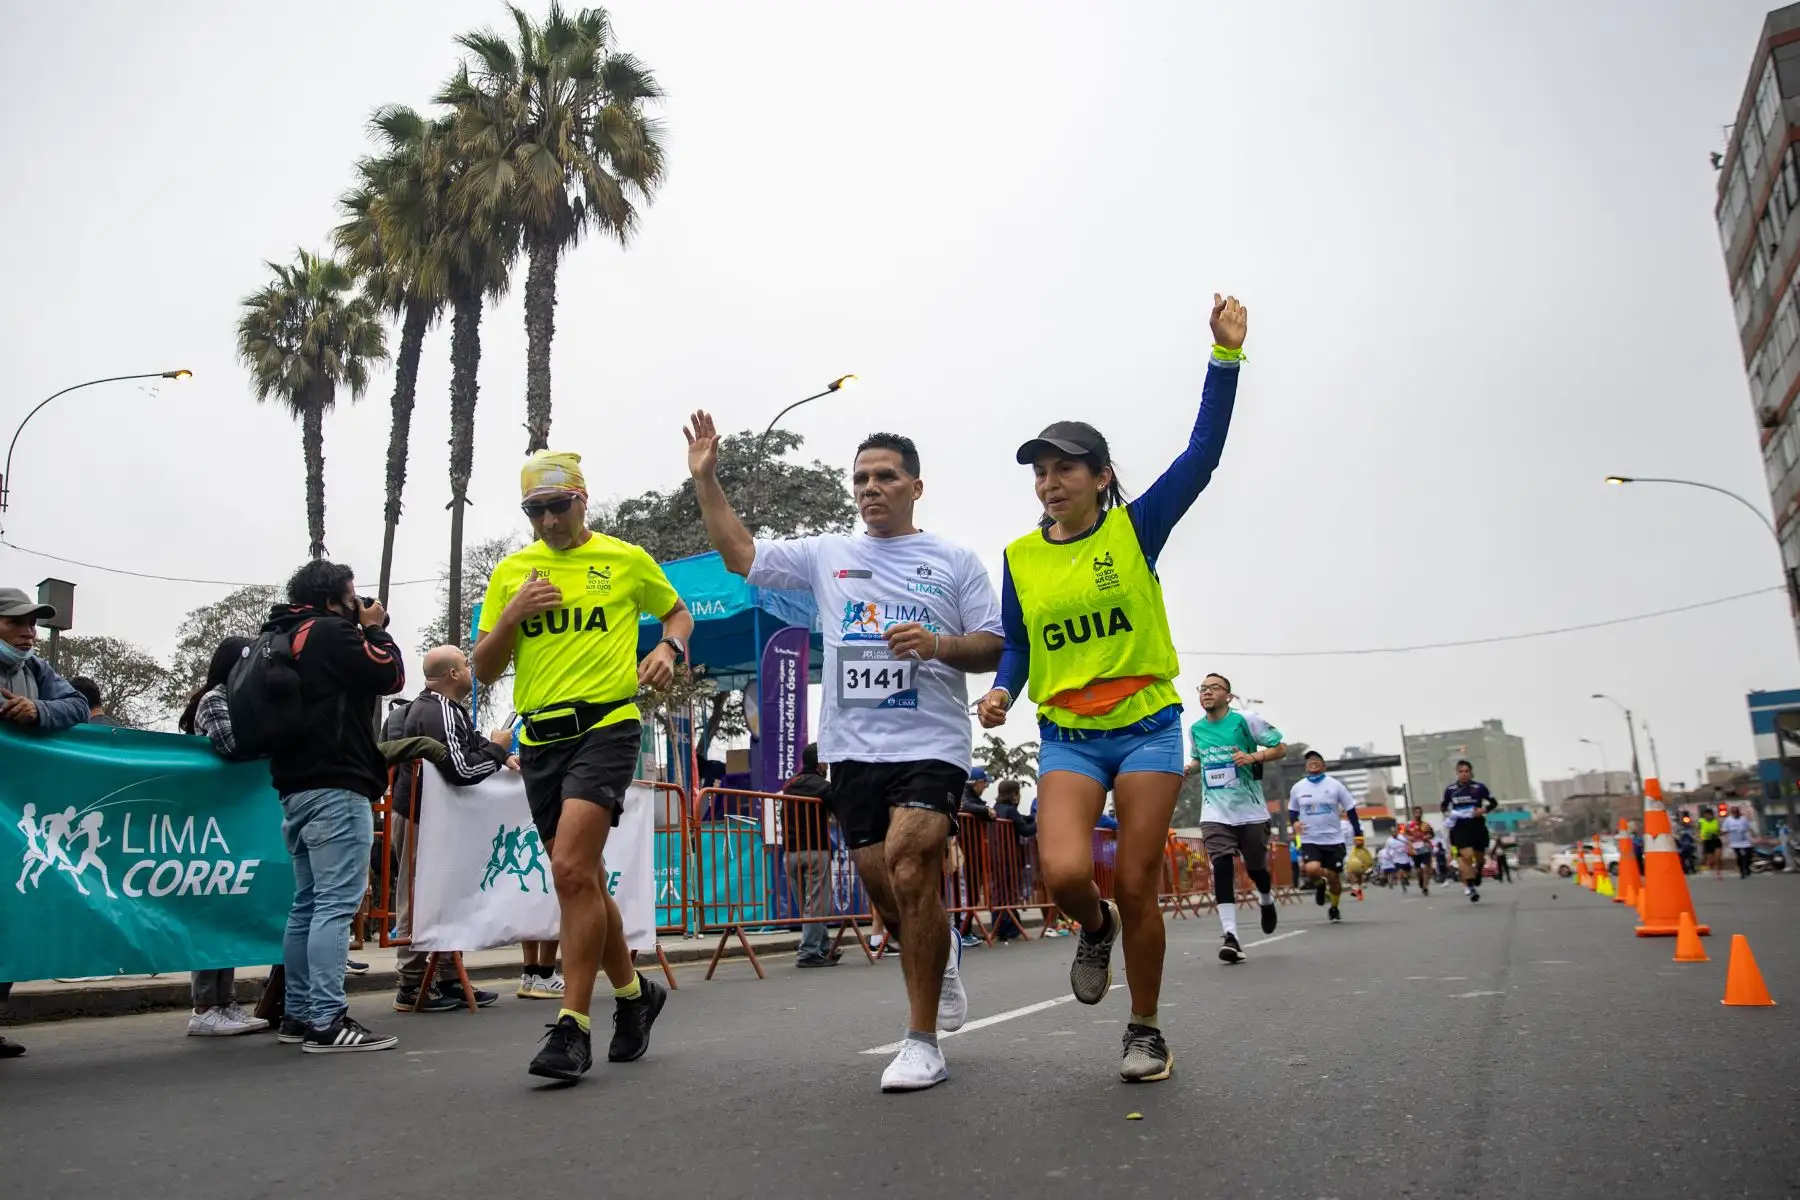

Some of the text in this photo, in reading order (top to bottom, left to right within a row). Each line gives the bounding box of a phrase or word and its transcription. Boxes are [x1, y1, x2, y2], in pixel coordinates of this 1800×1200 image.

[906, 582, 944, 595] LIMA
[521, 606, 608, 638] GUIA
[691, 600, 726, 615] IMA
[885, 604, 931, 624] LIMA
[1043, 607, 1133, 652] GUIA
[847, 668, 904, 689] 3141
[785, 659, 796, 780] Dona médula ósea
[122, 812, 230, 854] LIMA
[122, 859, 261, 898] CORRE
